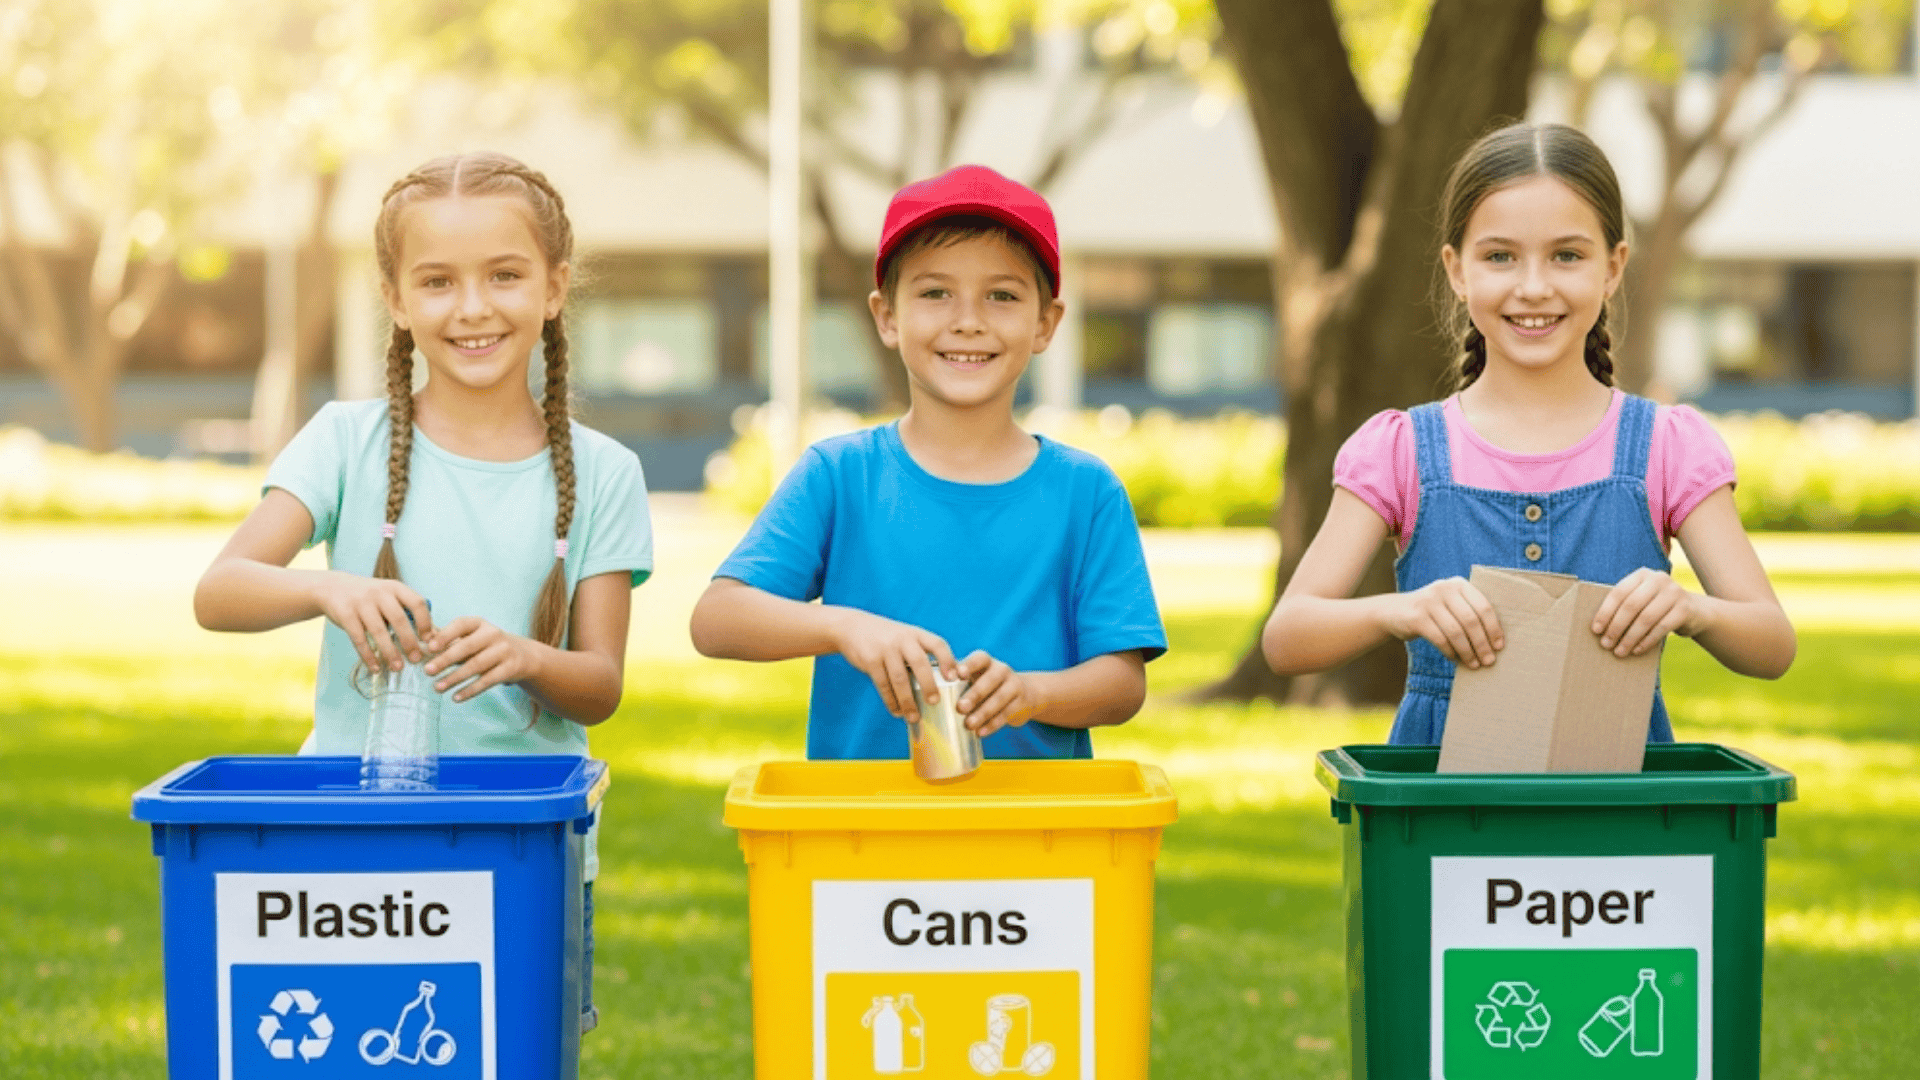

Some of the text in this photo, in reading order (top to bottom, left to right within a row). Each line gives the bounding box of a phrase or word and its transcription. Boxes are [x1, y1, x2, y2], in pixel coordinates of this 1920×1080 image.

[257, 890, 450, 939] Plastic
[882, 898, 1028, 946] Cans
[1485, 878, 1655, 938] Paper
